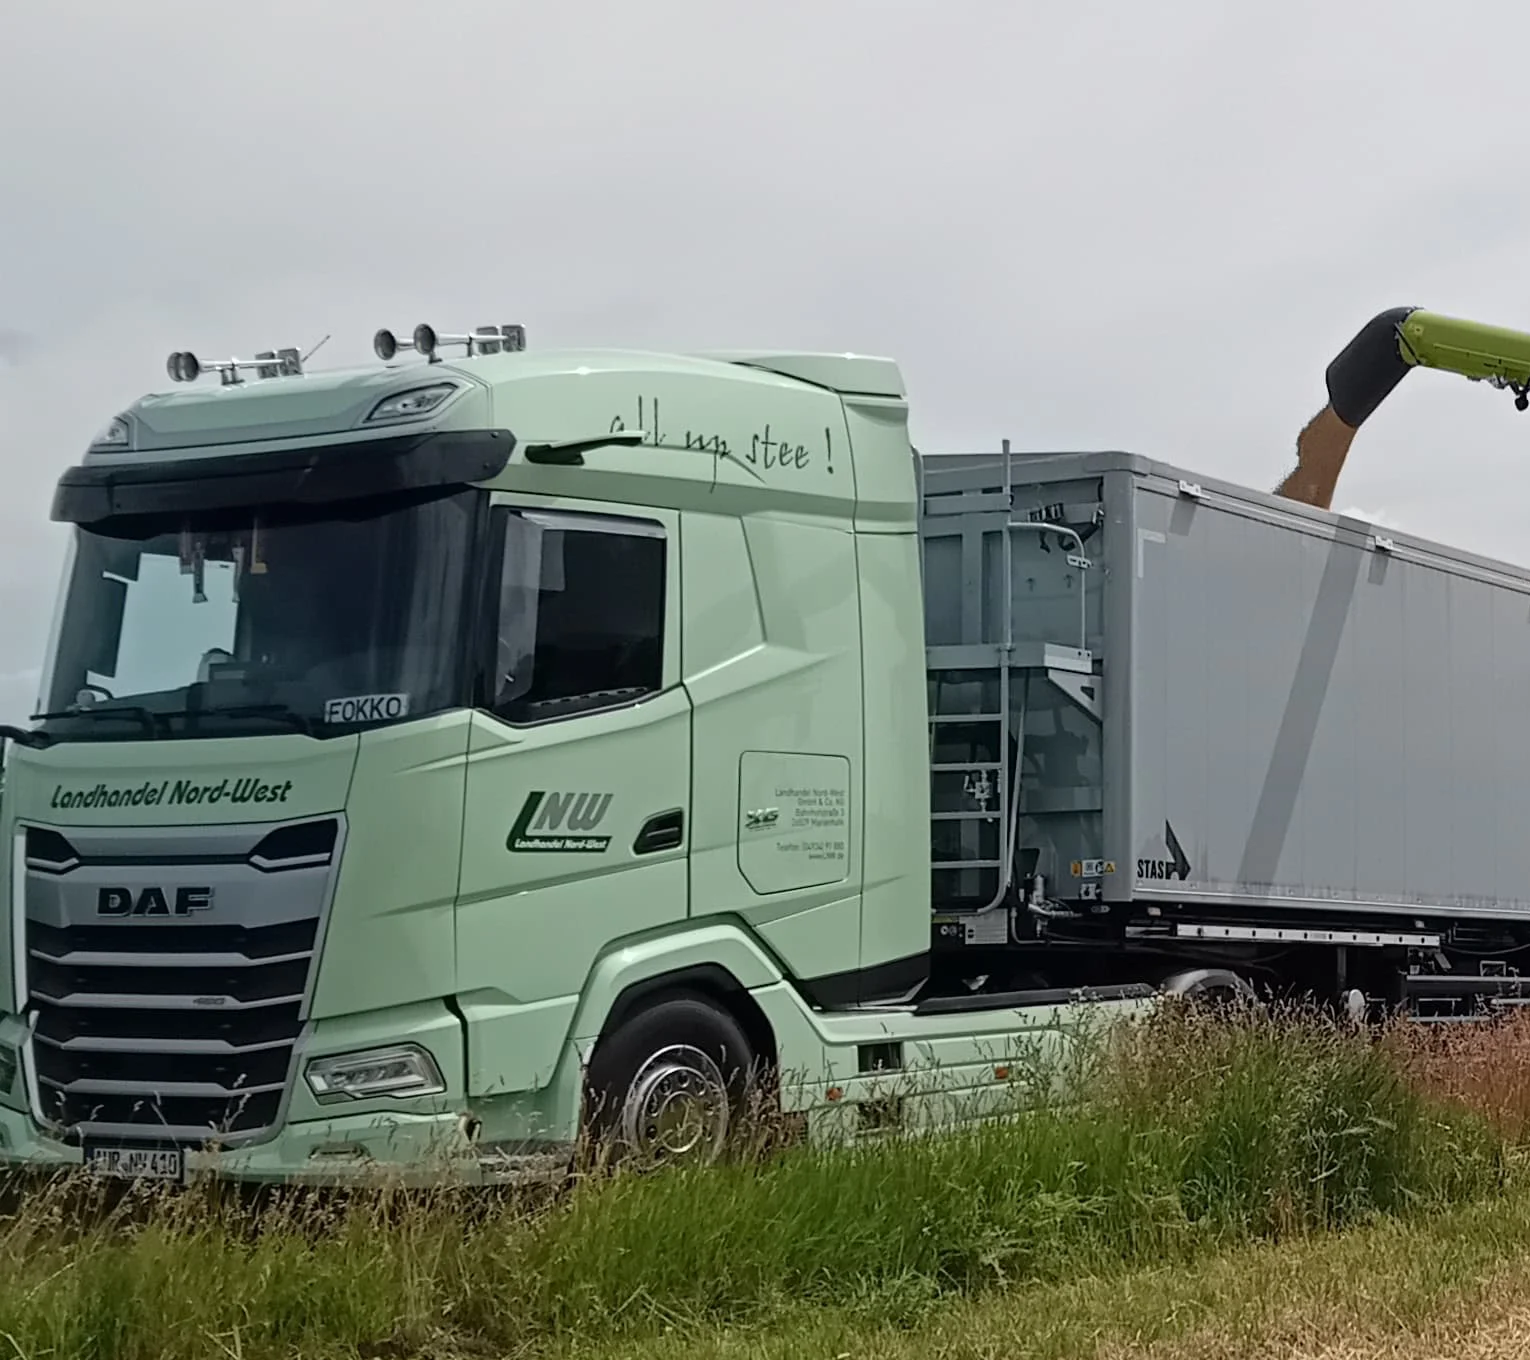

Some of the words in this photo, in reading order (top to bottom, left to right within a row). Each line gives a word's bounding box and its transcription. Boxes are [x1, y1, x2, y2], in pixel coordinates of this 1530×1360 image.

[329, 696, 402, 722] FOKKO
[50, 780, 169, 809] Landhandel
[168, 778, 293, 805] Nord-West
[1137, 858, 1165, 880] STAS
[98, 886, 214, 917] DAF
